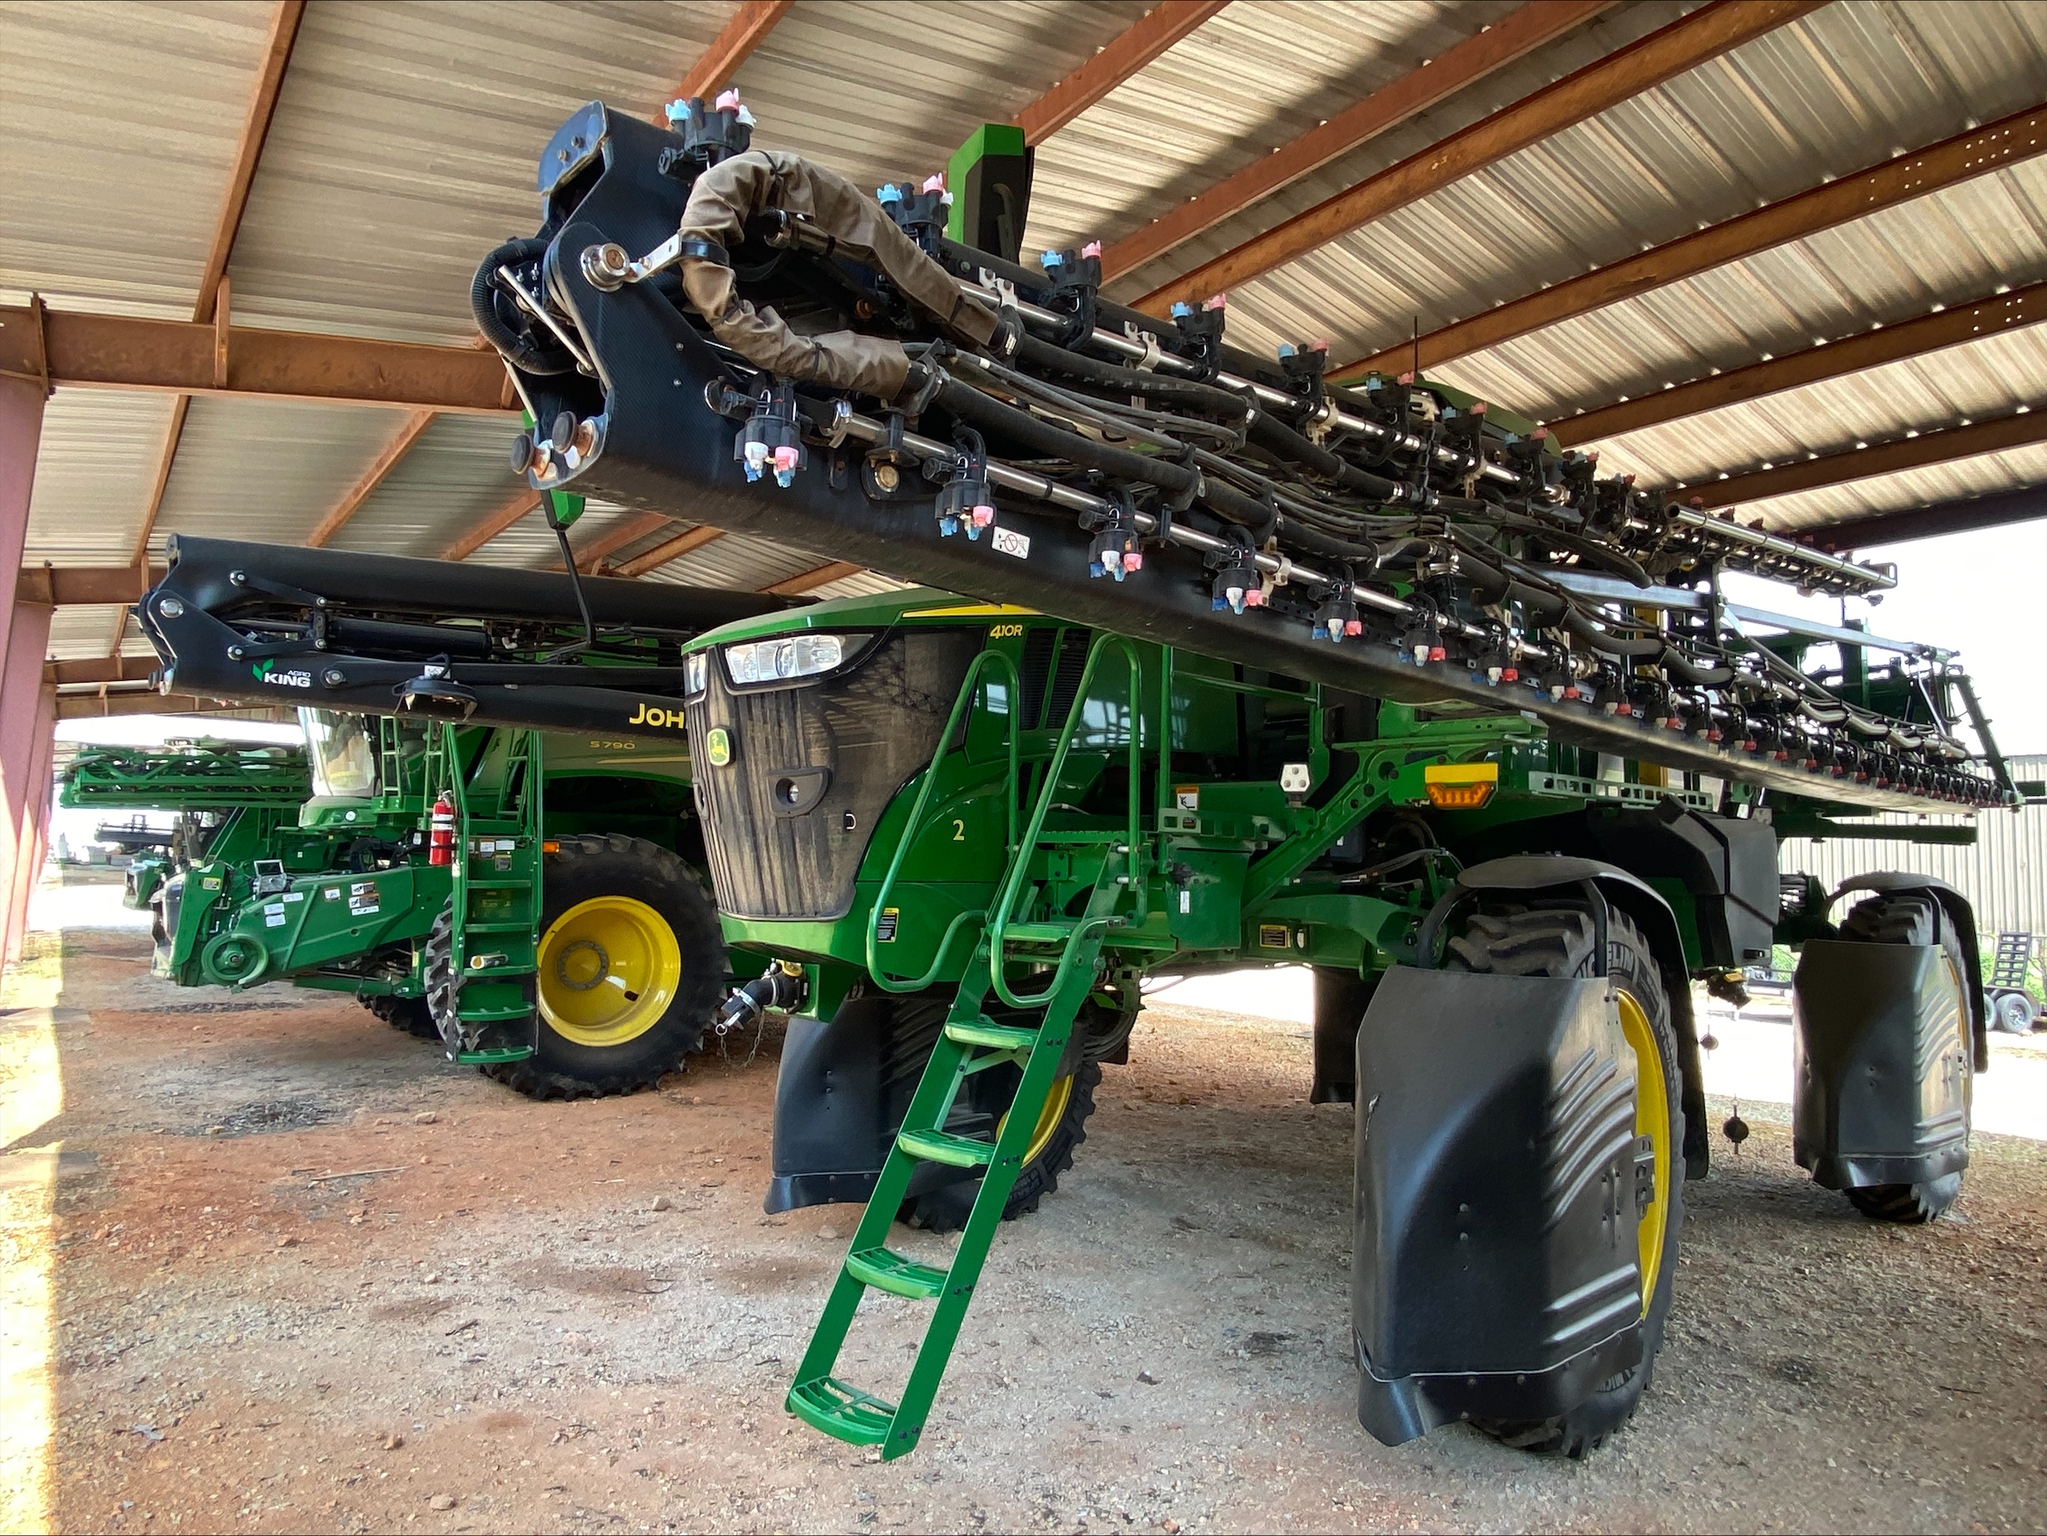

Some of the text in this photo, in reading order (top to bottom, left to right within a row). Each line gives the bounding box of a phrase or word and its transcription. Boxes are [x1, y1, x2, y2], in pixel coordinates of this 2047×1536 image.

[990, 624, 1023, 639] 410R
[264, 671, 311, 688] KING
[629, 703, 687, 729] JOH
[952, 819, 965, 841] 2
